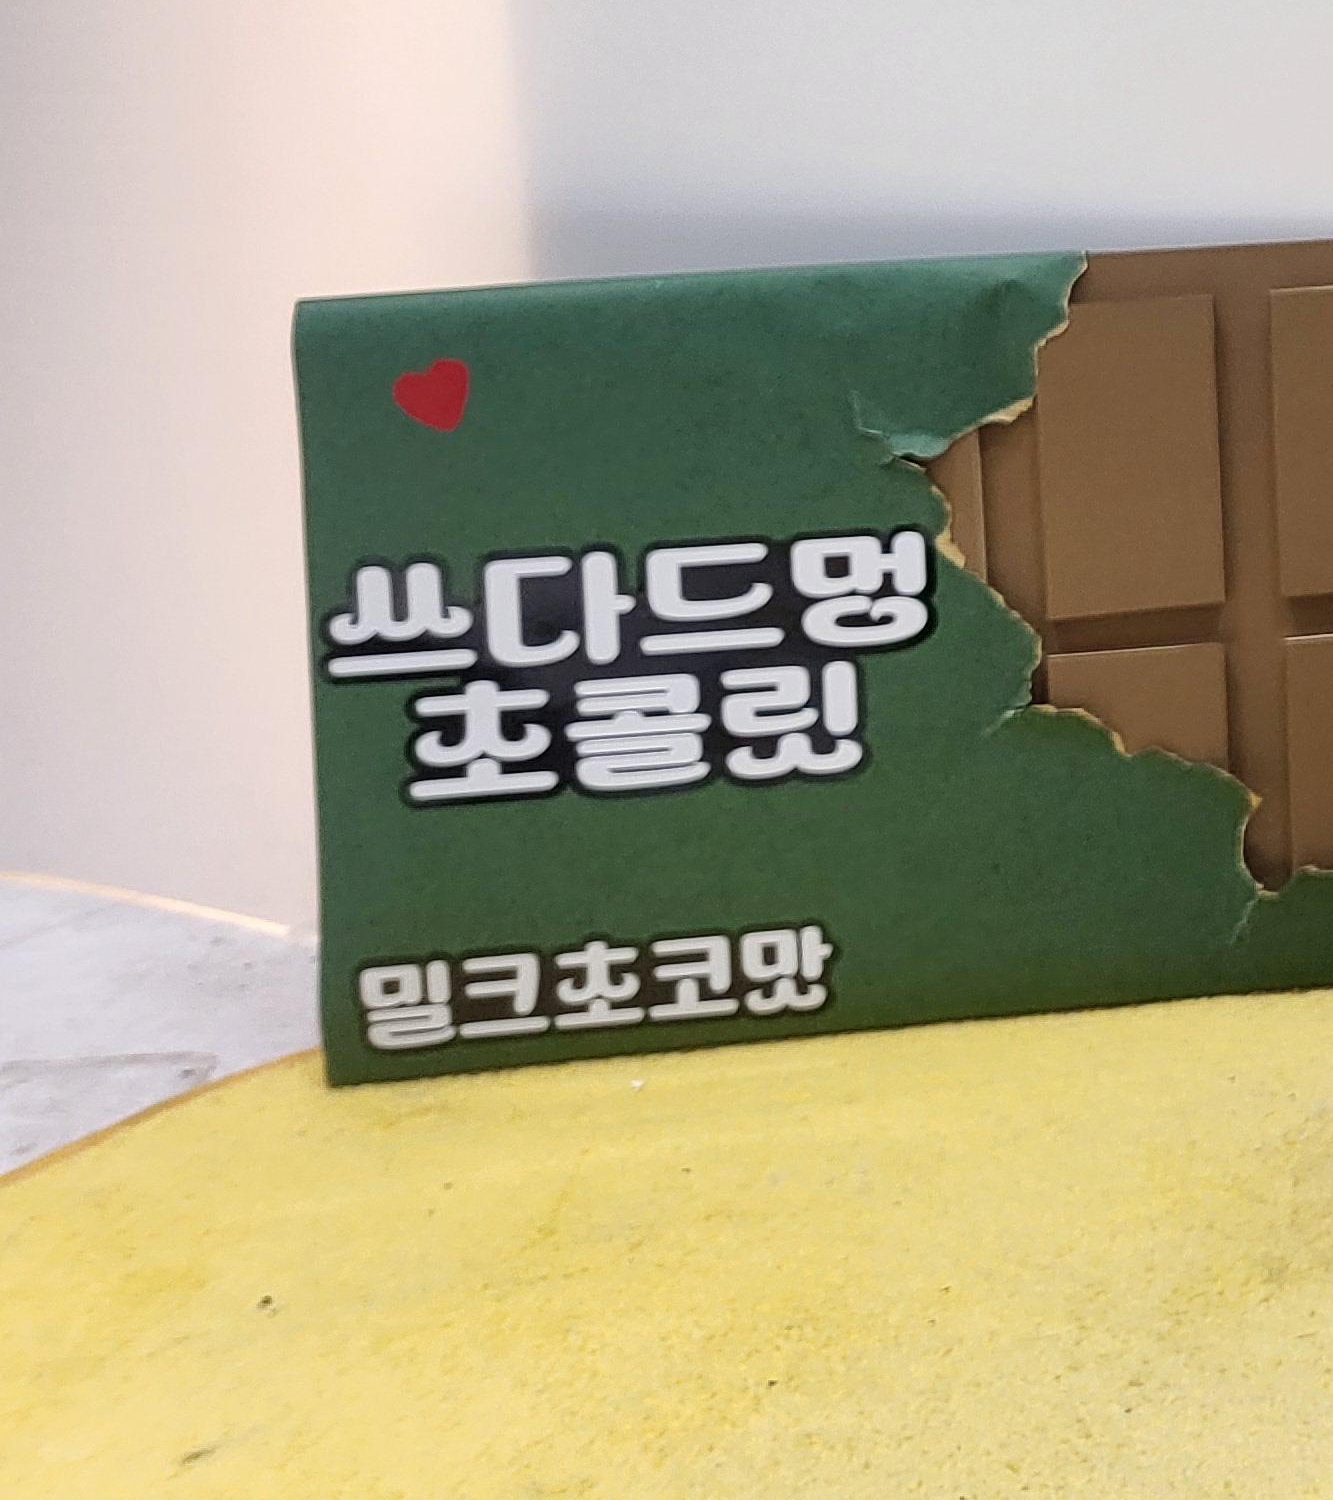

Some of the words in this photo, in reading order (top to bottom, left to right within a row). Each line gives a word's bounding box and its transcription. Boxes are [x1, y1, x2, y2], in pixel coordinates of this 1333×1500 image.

[322, 528, 934, 680] 쓰다드멍
[405, 658, 868, 803] 초콜릿
[357, 922, 836, 1052] 밀크초코맛
